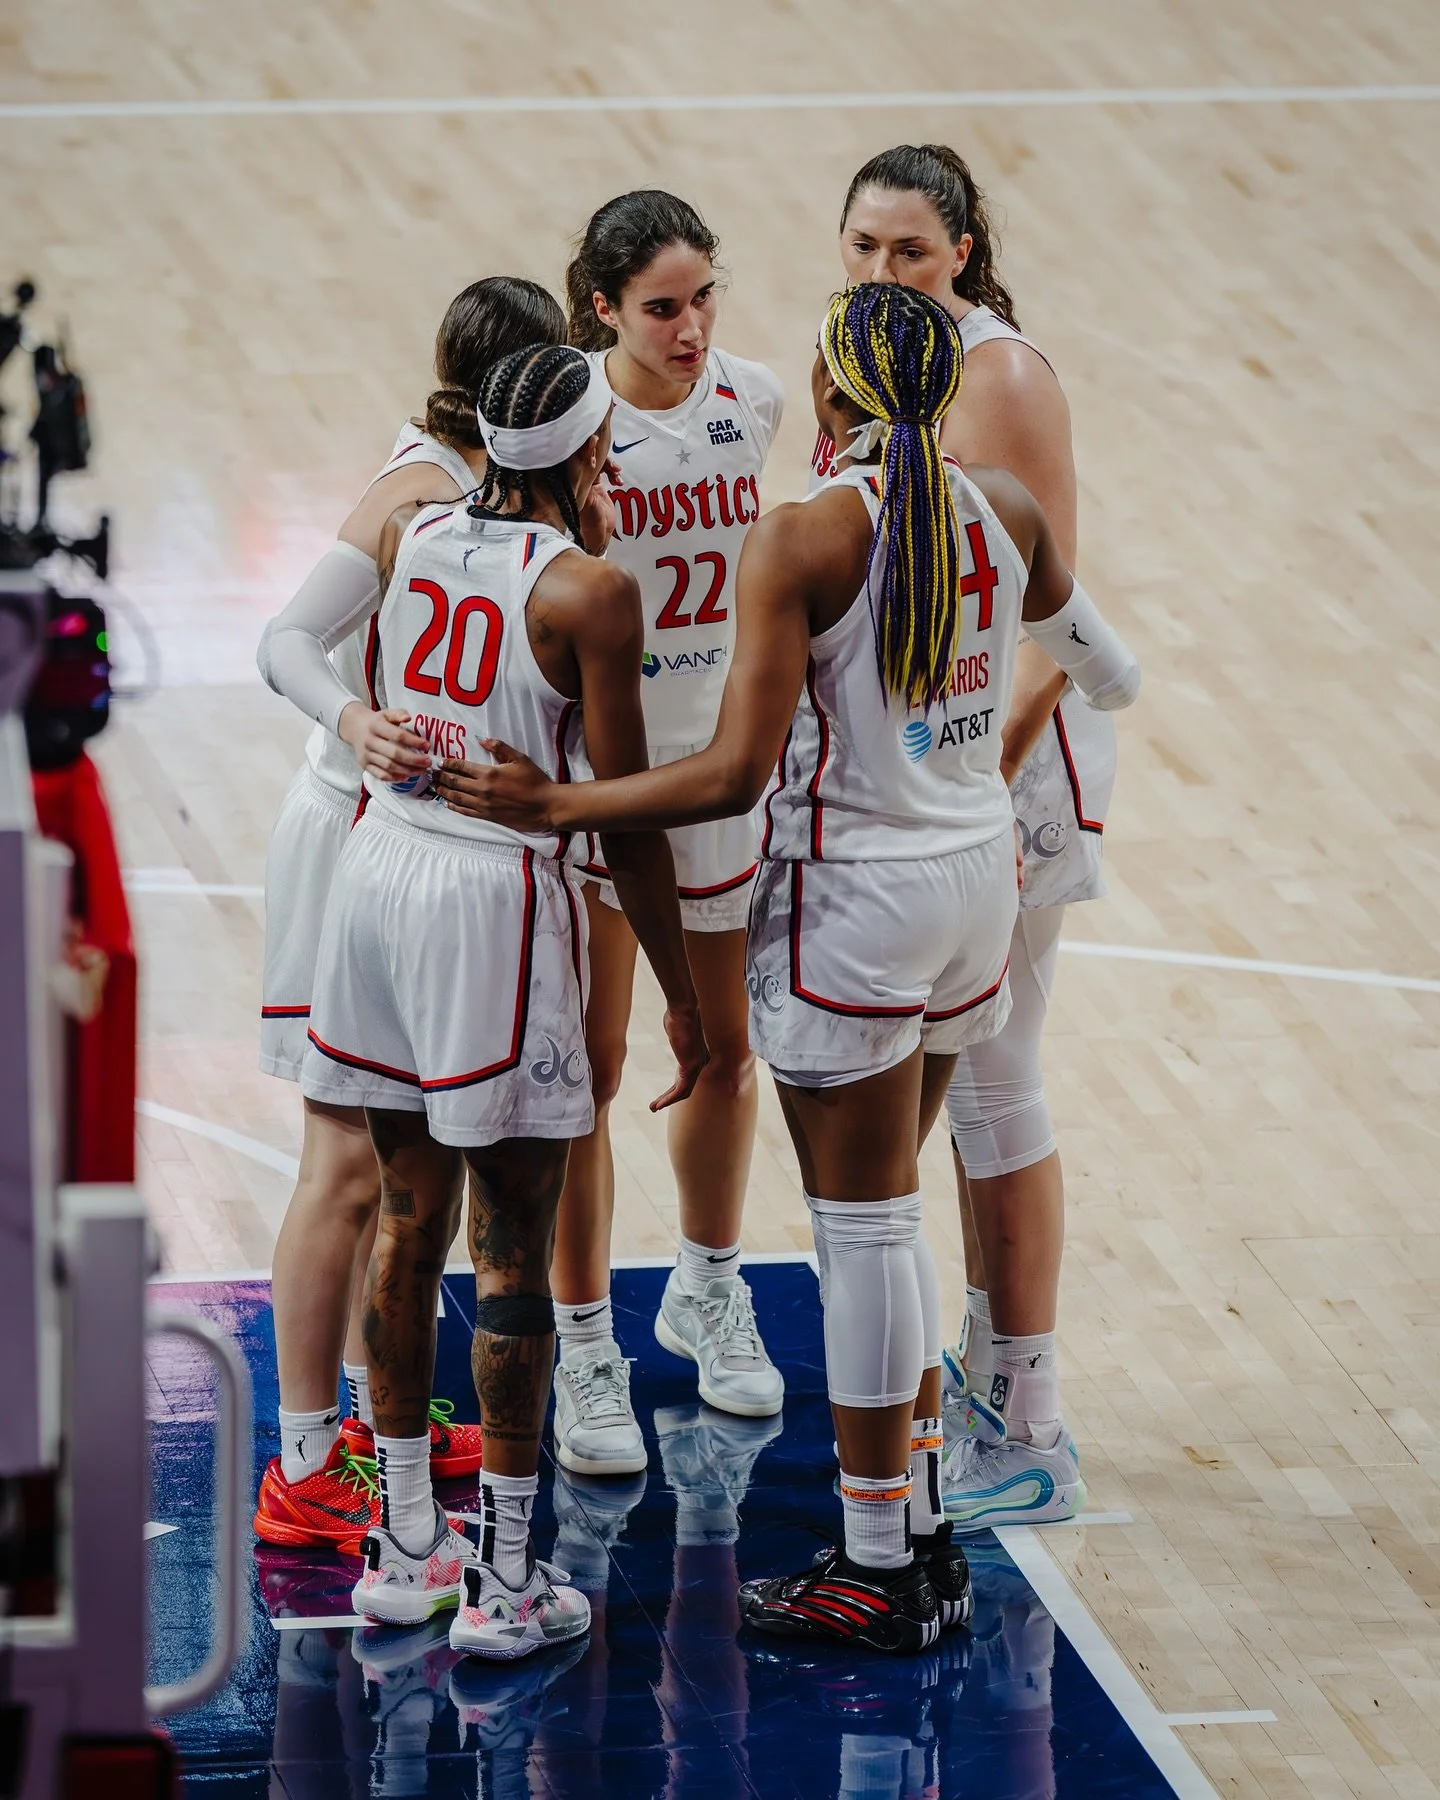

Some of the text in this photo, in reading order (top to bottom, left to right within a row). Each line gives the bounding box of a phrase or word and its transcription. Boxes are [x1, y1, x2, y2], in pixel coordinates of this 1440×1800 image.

[707, 418, 735, 433] CAR
[709, 429, 744, 446] max
[655, 551, 728, 630] 22
[403, 577, 504, 707] 20
[663, 645, 727, 670] VAND
[938, 707, 994, 750] AT&T
